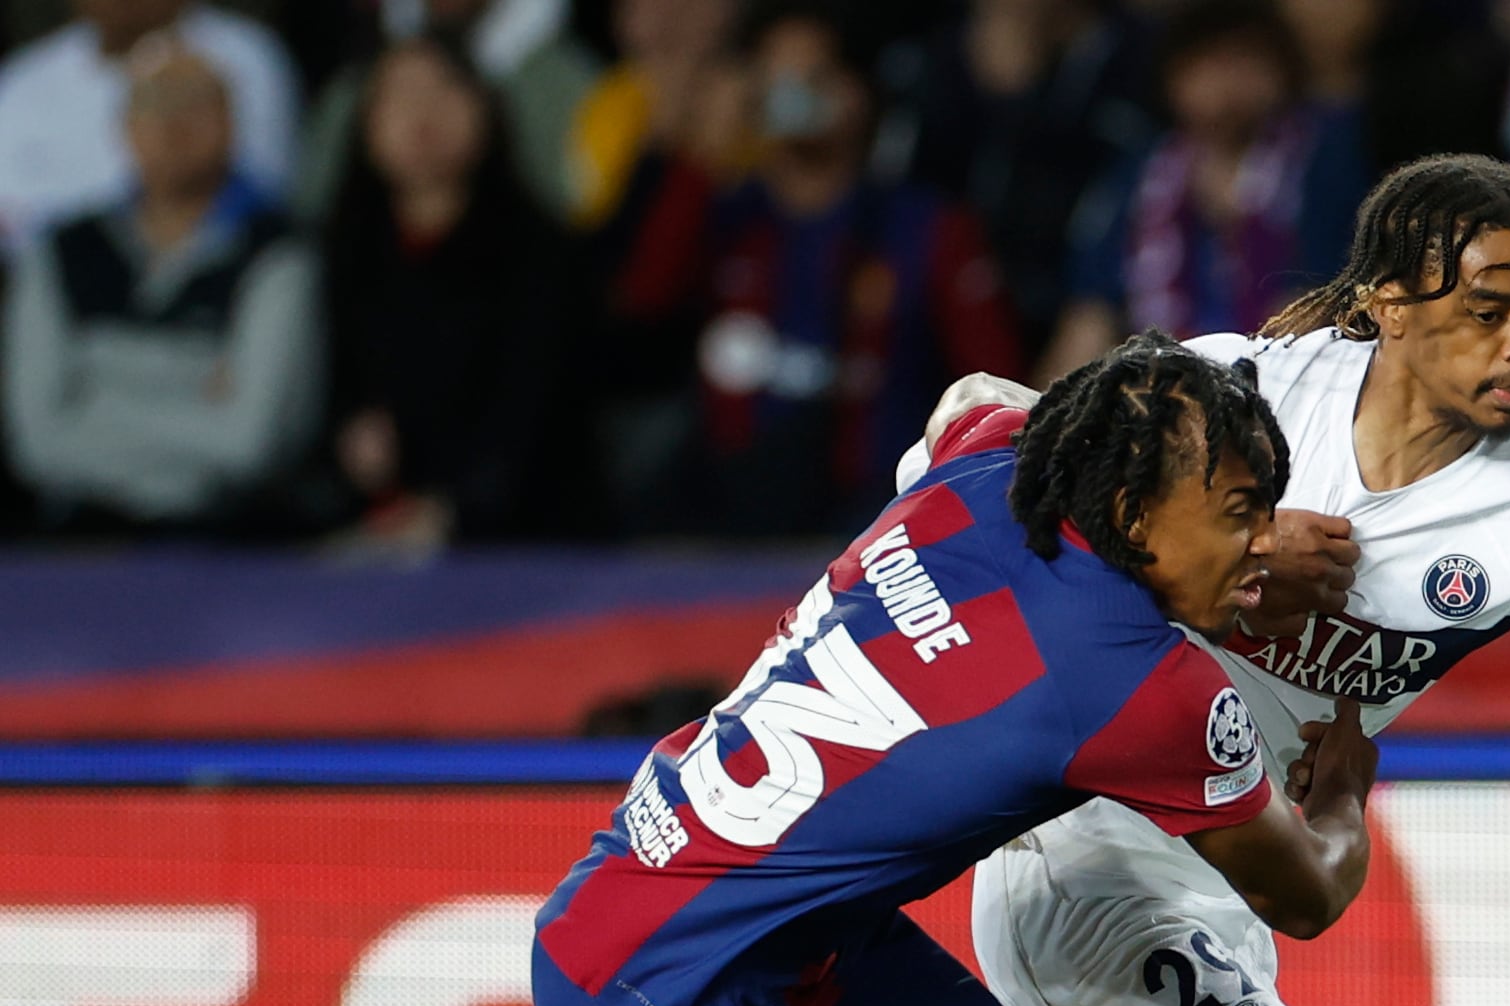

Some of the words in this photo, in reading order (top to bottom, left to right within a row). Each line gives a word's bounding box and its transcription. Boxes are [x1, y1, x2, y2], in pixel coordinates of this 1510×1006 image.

[860, 522, 971, 664] KOUNDE
[1437, 559, 1481, 578] PARIS
[1248, 641, 1406, 697] AIRWAYS
[1266, 611, 1437, 675] TAR
[628, 796, 672, 869] ACNUR
[642, 775, 690, 855] UNHCR
